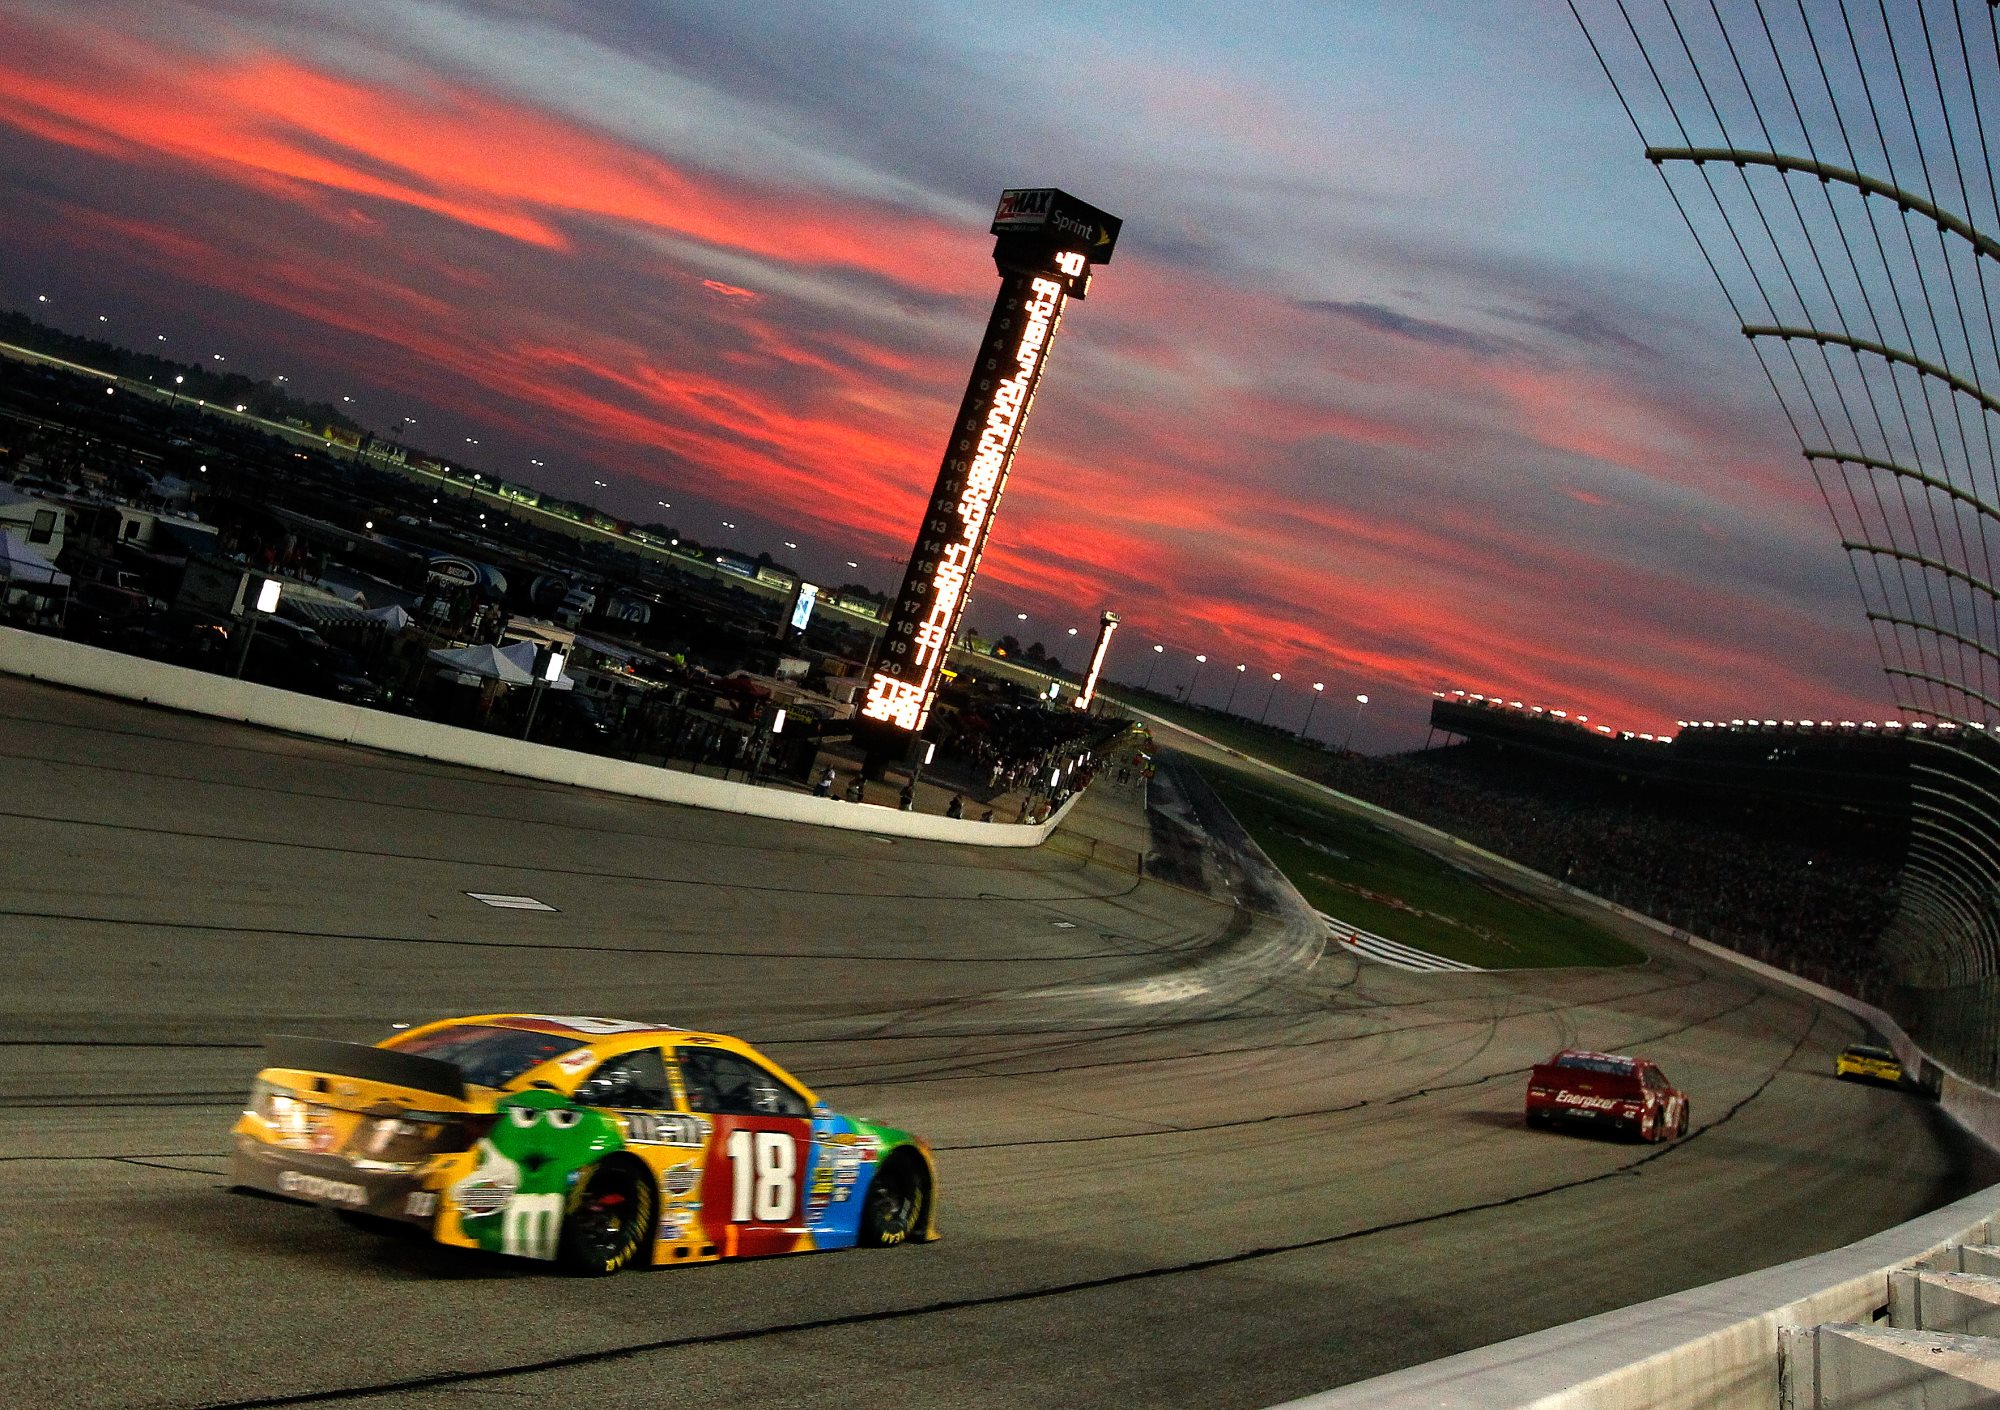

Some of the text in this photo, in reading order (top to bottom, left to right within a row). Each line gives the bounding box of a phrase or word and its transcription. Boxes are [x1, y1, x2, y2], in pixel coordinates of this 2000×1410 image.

[1052, 209, 1094, 240] Sprint
[1055, 252, 1086, 277] 40
[1016, 277, 1062, 306] 1 99
[999, 318, 1010, 330] 3
[1007, 299, 1055, 326] 2 42
[992, 339, 1004, 351] 4
[986, 359, 1035, 387] 5 2
[972, 399, 984, 411] 7
[979, 378, 1028, 407] 6 20
[959, 440, 970, 452] 9
[966, 419, 1014, 448] 8 29
[948, 458, 1000, 489] 10 88
[944, 479, 994, 509] 11 22
[935, 499, 987, 529] 12 43
[929, 519, 980, 549] 13 9
[922, 540, 974, 571] 14 47
[909, 580, 927, 594] 16
[916, 560, 967, 590] 15 55
[902, 600, 920, 614] 17
[888, 640, 907, 655] 19
[895, 620, 947, 651] 18 33
[880, 660, 902, 675] 20
[1555, 1089, 1618, 1109] Energizer
[727, 1129, 797, 1222] 18
